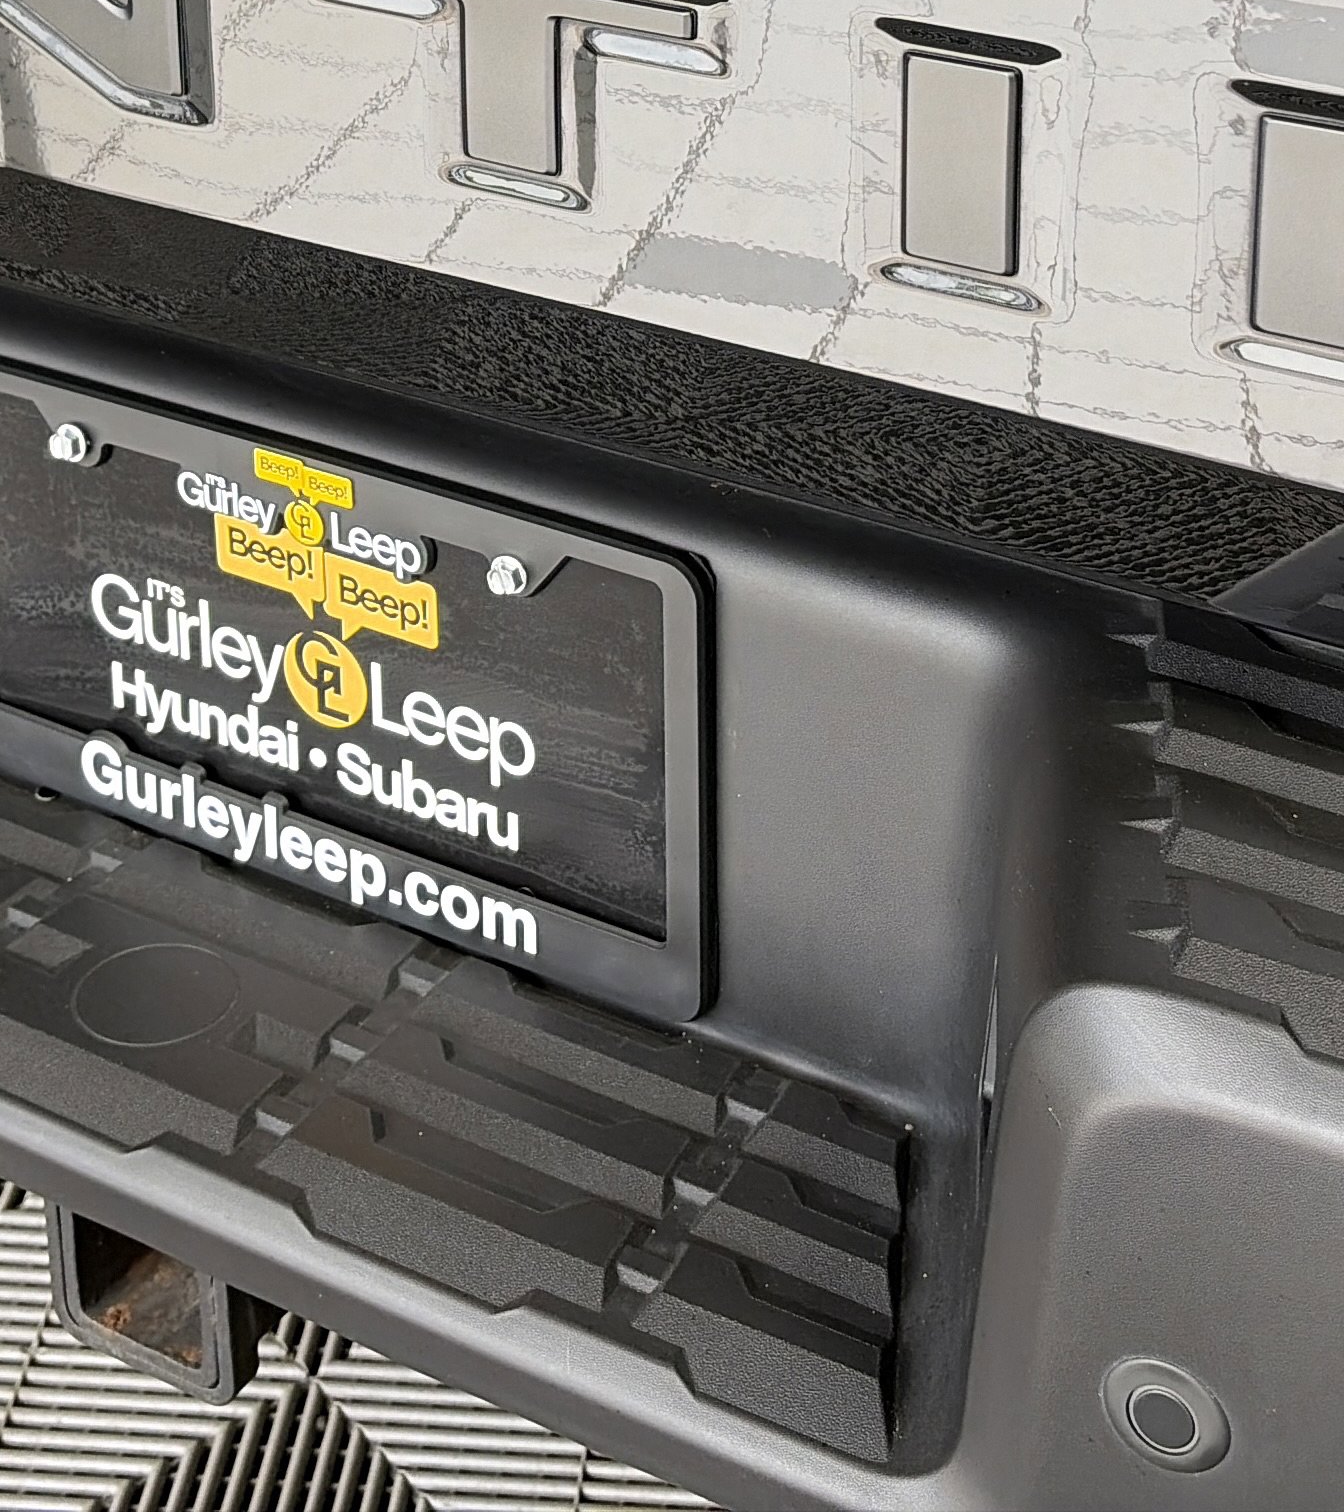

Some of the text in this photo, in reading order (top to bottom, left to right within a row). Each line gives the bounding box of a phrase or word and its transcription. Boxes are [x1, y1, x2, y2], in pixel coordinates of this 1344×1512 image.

[259, 455, 300, 481] Beep!
[307, 474, 349, 500] Beep!
[176, 470, 276, 535] Gurley
[330, 511, 422, 580] Leep
[228, 525, 315, 581] Beep!
[338, 572, 429, 631] Beep!
[90, 572, 285, 704] Gurley
[370, 661, 536, 787] Leep
[110, 660, 520, 852] Hyundai Subaru
[80, 738, 539, 955] Gurleyleep.com
